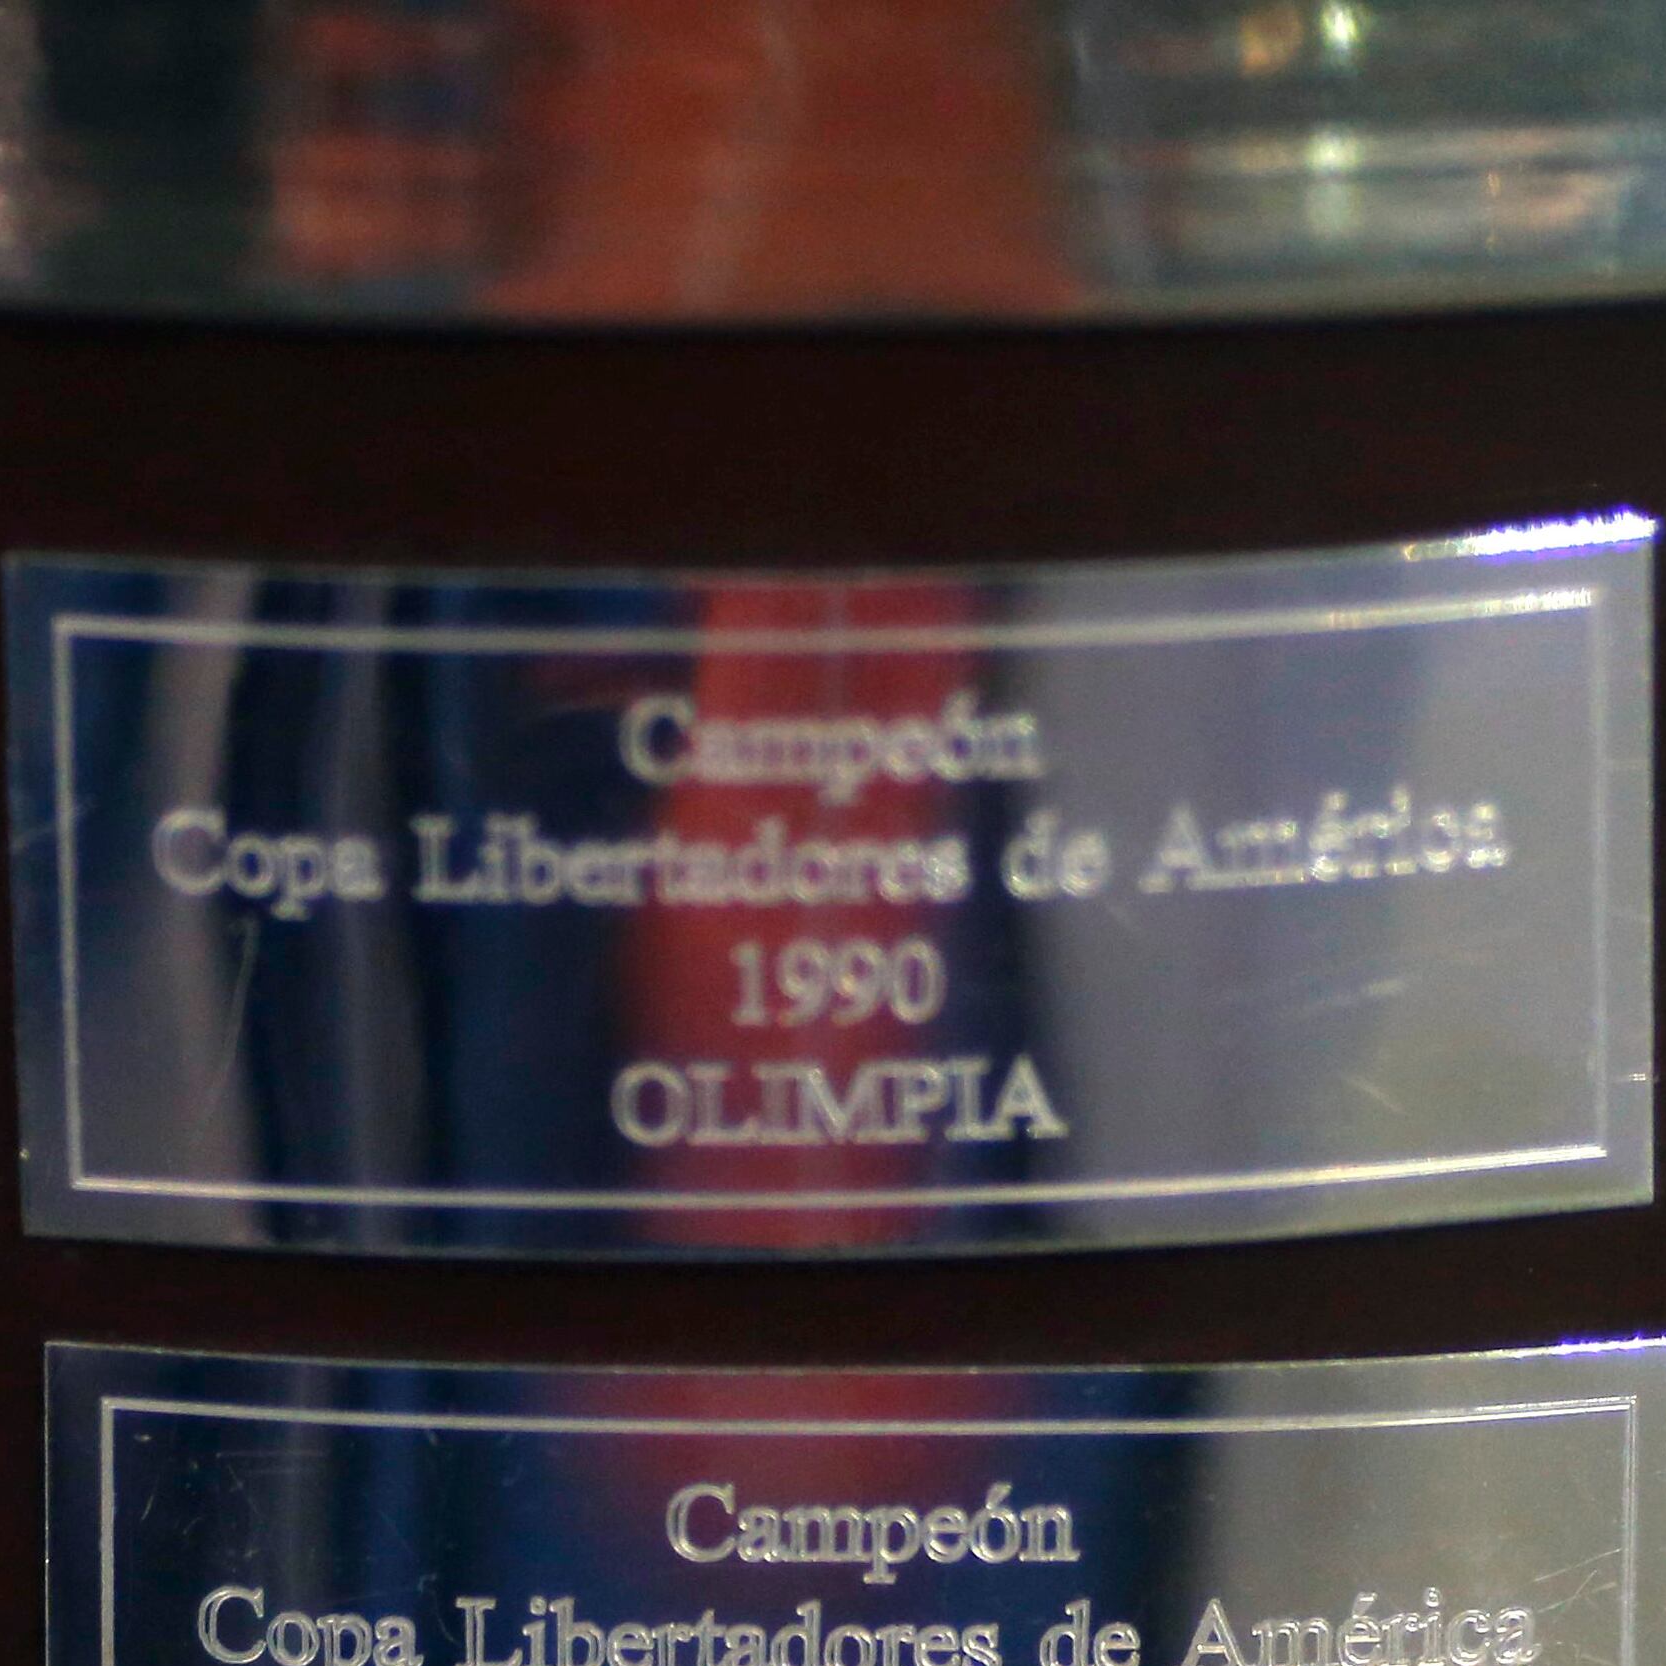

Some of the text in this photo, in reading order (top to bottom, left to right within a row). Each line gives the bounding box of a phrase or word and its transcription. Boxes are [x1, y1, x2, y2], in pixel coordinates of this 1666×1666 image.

[620, 692, 1043, 804] Campeón
[153, 785, 1509, 918] Copa Libertadores de América
[731, 938, 943, 1027] 1990
[613, 1057, 1065, 1147] OLIMPIA
[667, 1483, 1080, 1584] Campeón
